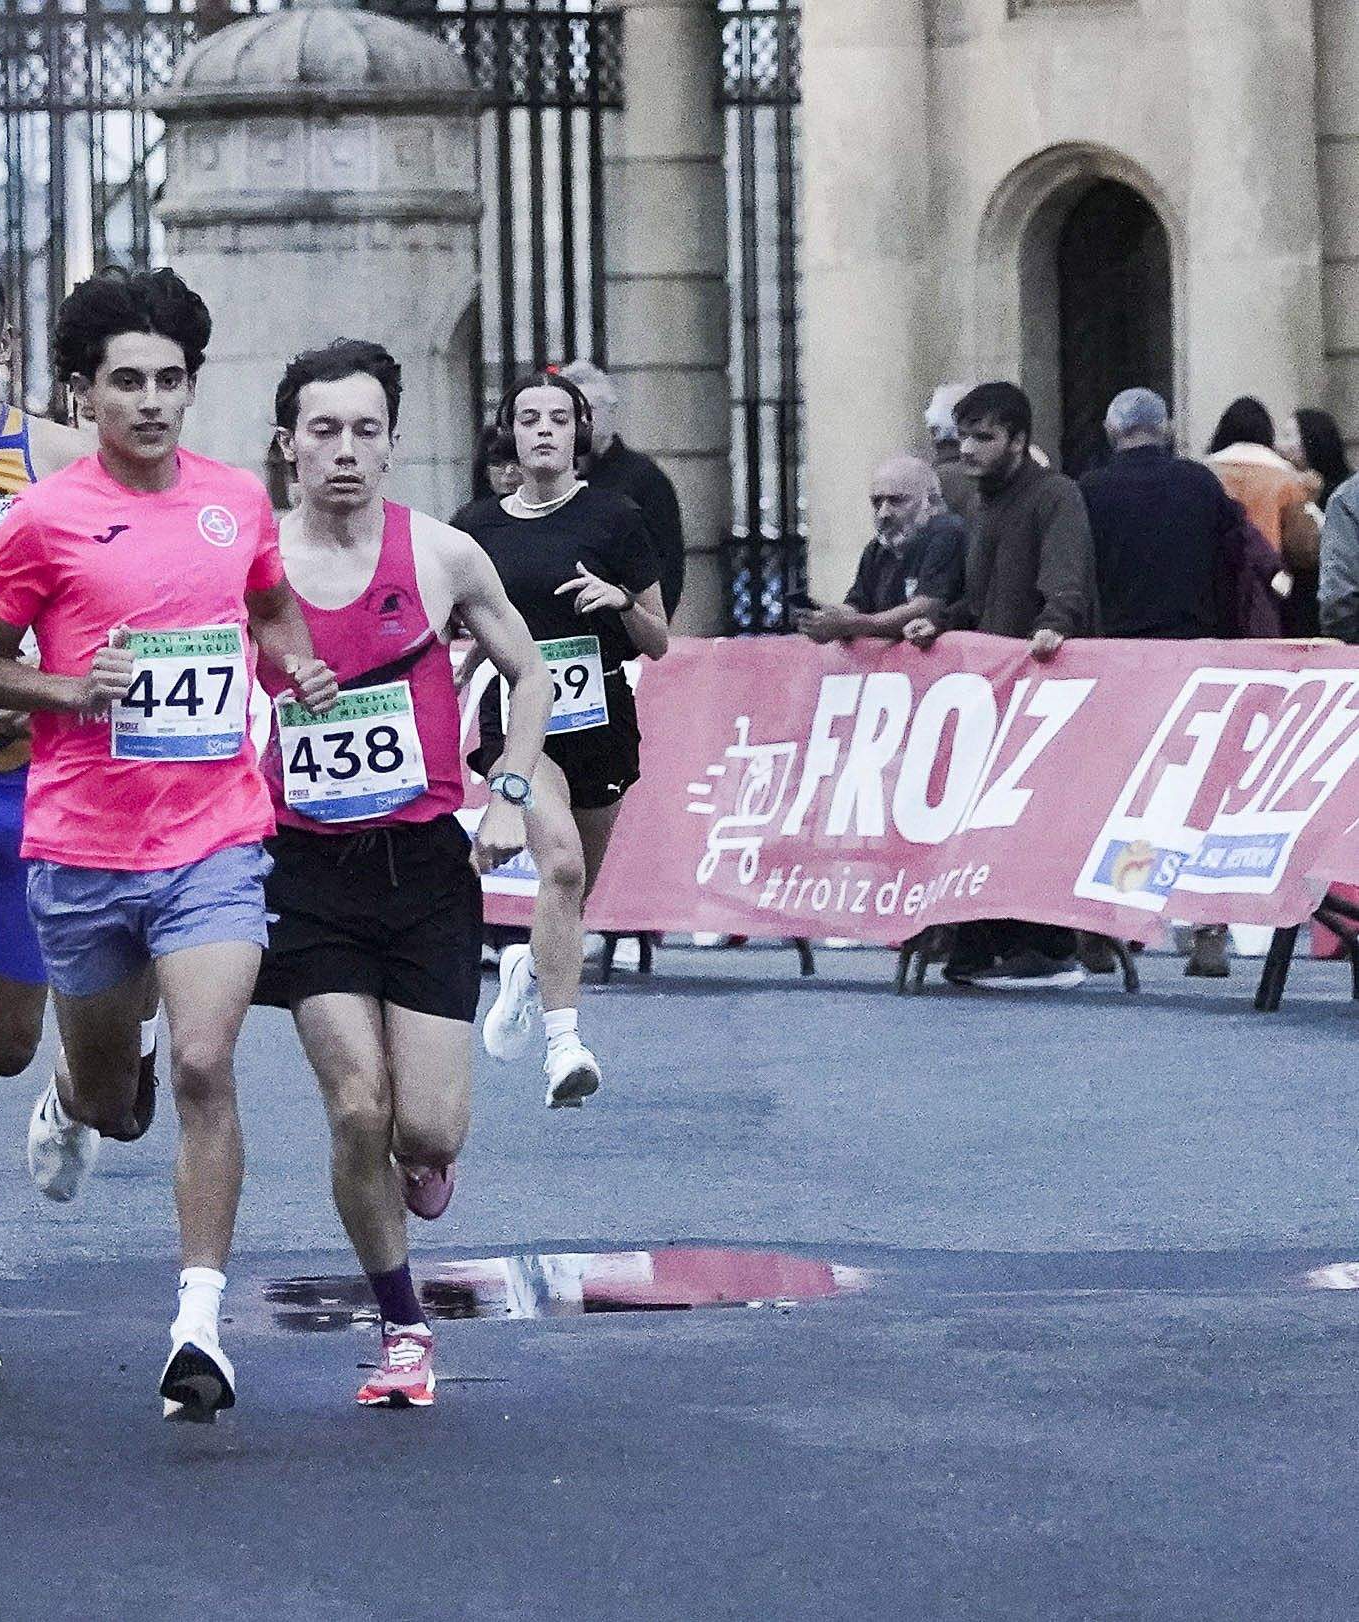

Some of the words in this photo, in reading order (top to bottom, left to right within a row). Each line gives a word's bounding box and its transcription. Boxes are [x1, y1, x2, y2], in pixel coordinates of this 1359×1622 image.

[121, 666, 234, 718] 447
[289, 725, 404, 782] 438
[781, 671, 1099, 844] FROIZ
